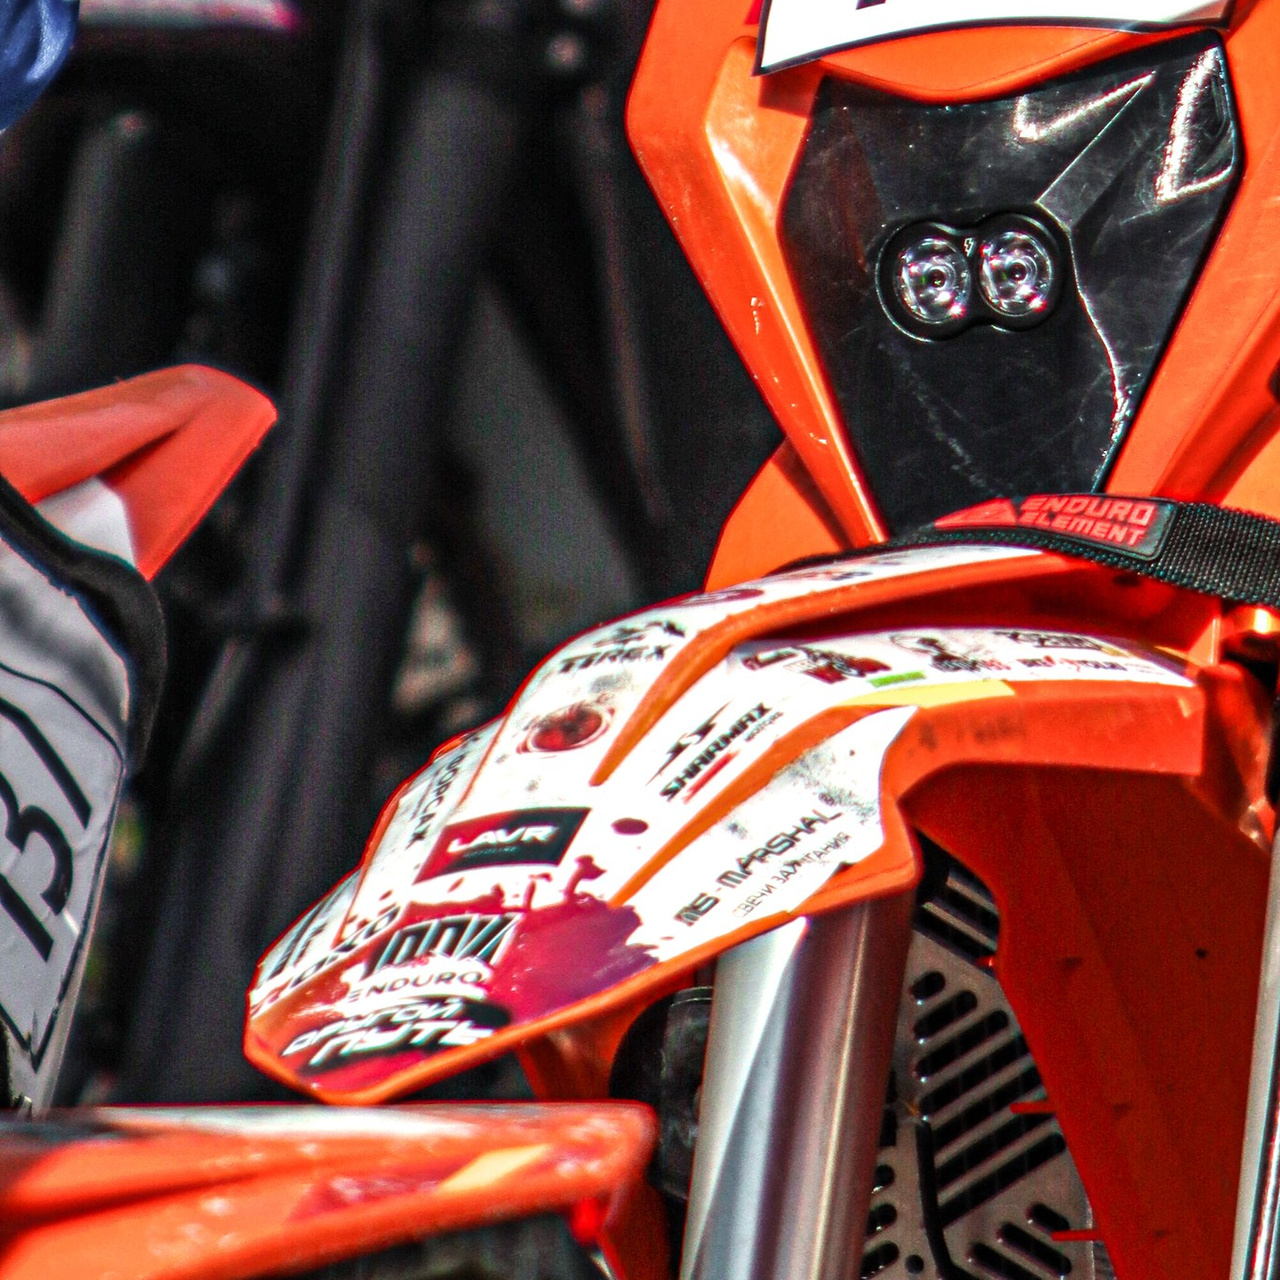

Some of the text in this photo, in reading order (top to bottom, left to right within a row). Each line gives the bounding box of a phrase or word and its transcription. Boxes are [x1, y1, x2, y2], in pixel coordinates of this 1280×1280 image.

[1019, 496, 1157, 527] ENDURO
[1017, 511, 1147, 546] ELEMENT
[660, 701, 773, 802] SHARMAX
[446, 825, 559, 853] LAVR
[347, 970, 484, 1003] ENDURO
